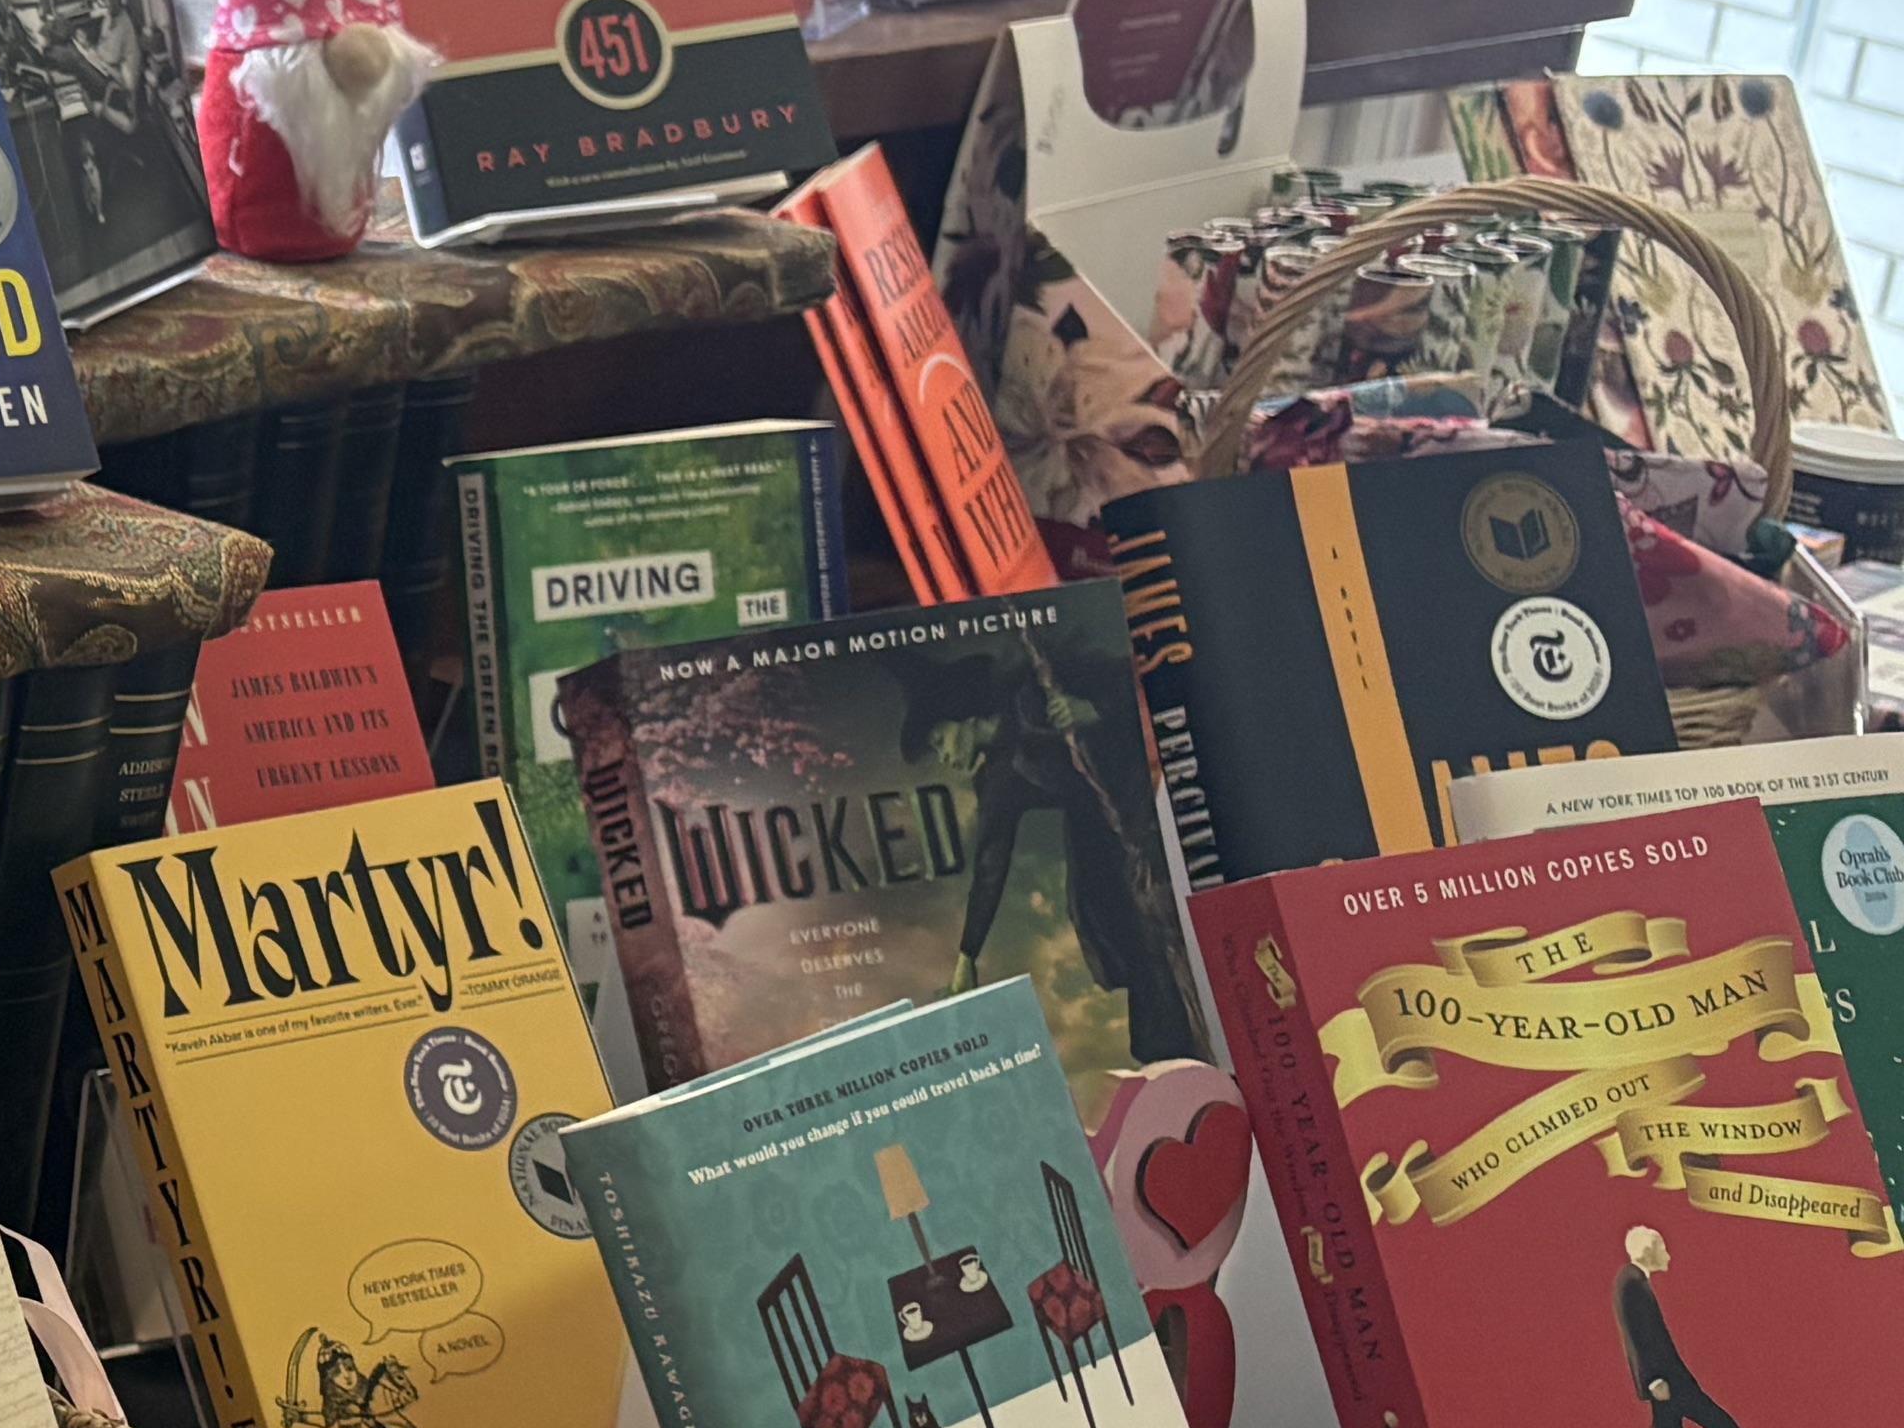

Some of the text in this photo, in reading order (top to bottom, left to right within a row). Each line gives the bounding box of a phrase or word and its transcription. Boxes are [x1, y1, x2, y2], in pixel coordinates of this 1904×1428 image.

[578, 12, 650, 81] 451
[476, 140, 551, 174] RAY
[577, 103, 799, 160] BRADBURY
[544, 562, 783, 622] DRIVING THE
[658, 605, 1061, 683] NOW A MAJOR MOTION PICTURE
[230, 663, 379, 701] JAMES BALDWIN'S
[241, 707, 390, 744] AMERICA AND ITS
[256, 750, 402, 788] URGENT LESSONS
[649, 784, 966, 928] WICKED
[1342, 834, 1711, 917] OVER 5 MILLION COPIES SOLD
[117, 798, 545, 1020] Martyr!
[1395, 968, 1772, 1042] 100-YEAR-OLD MAN
